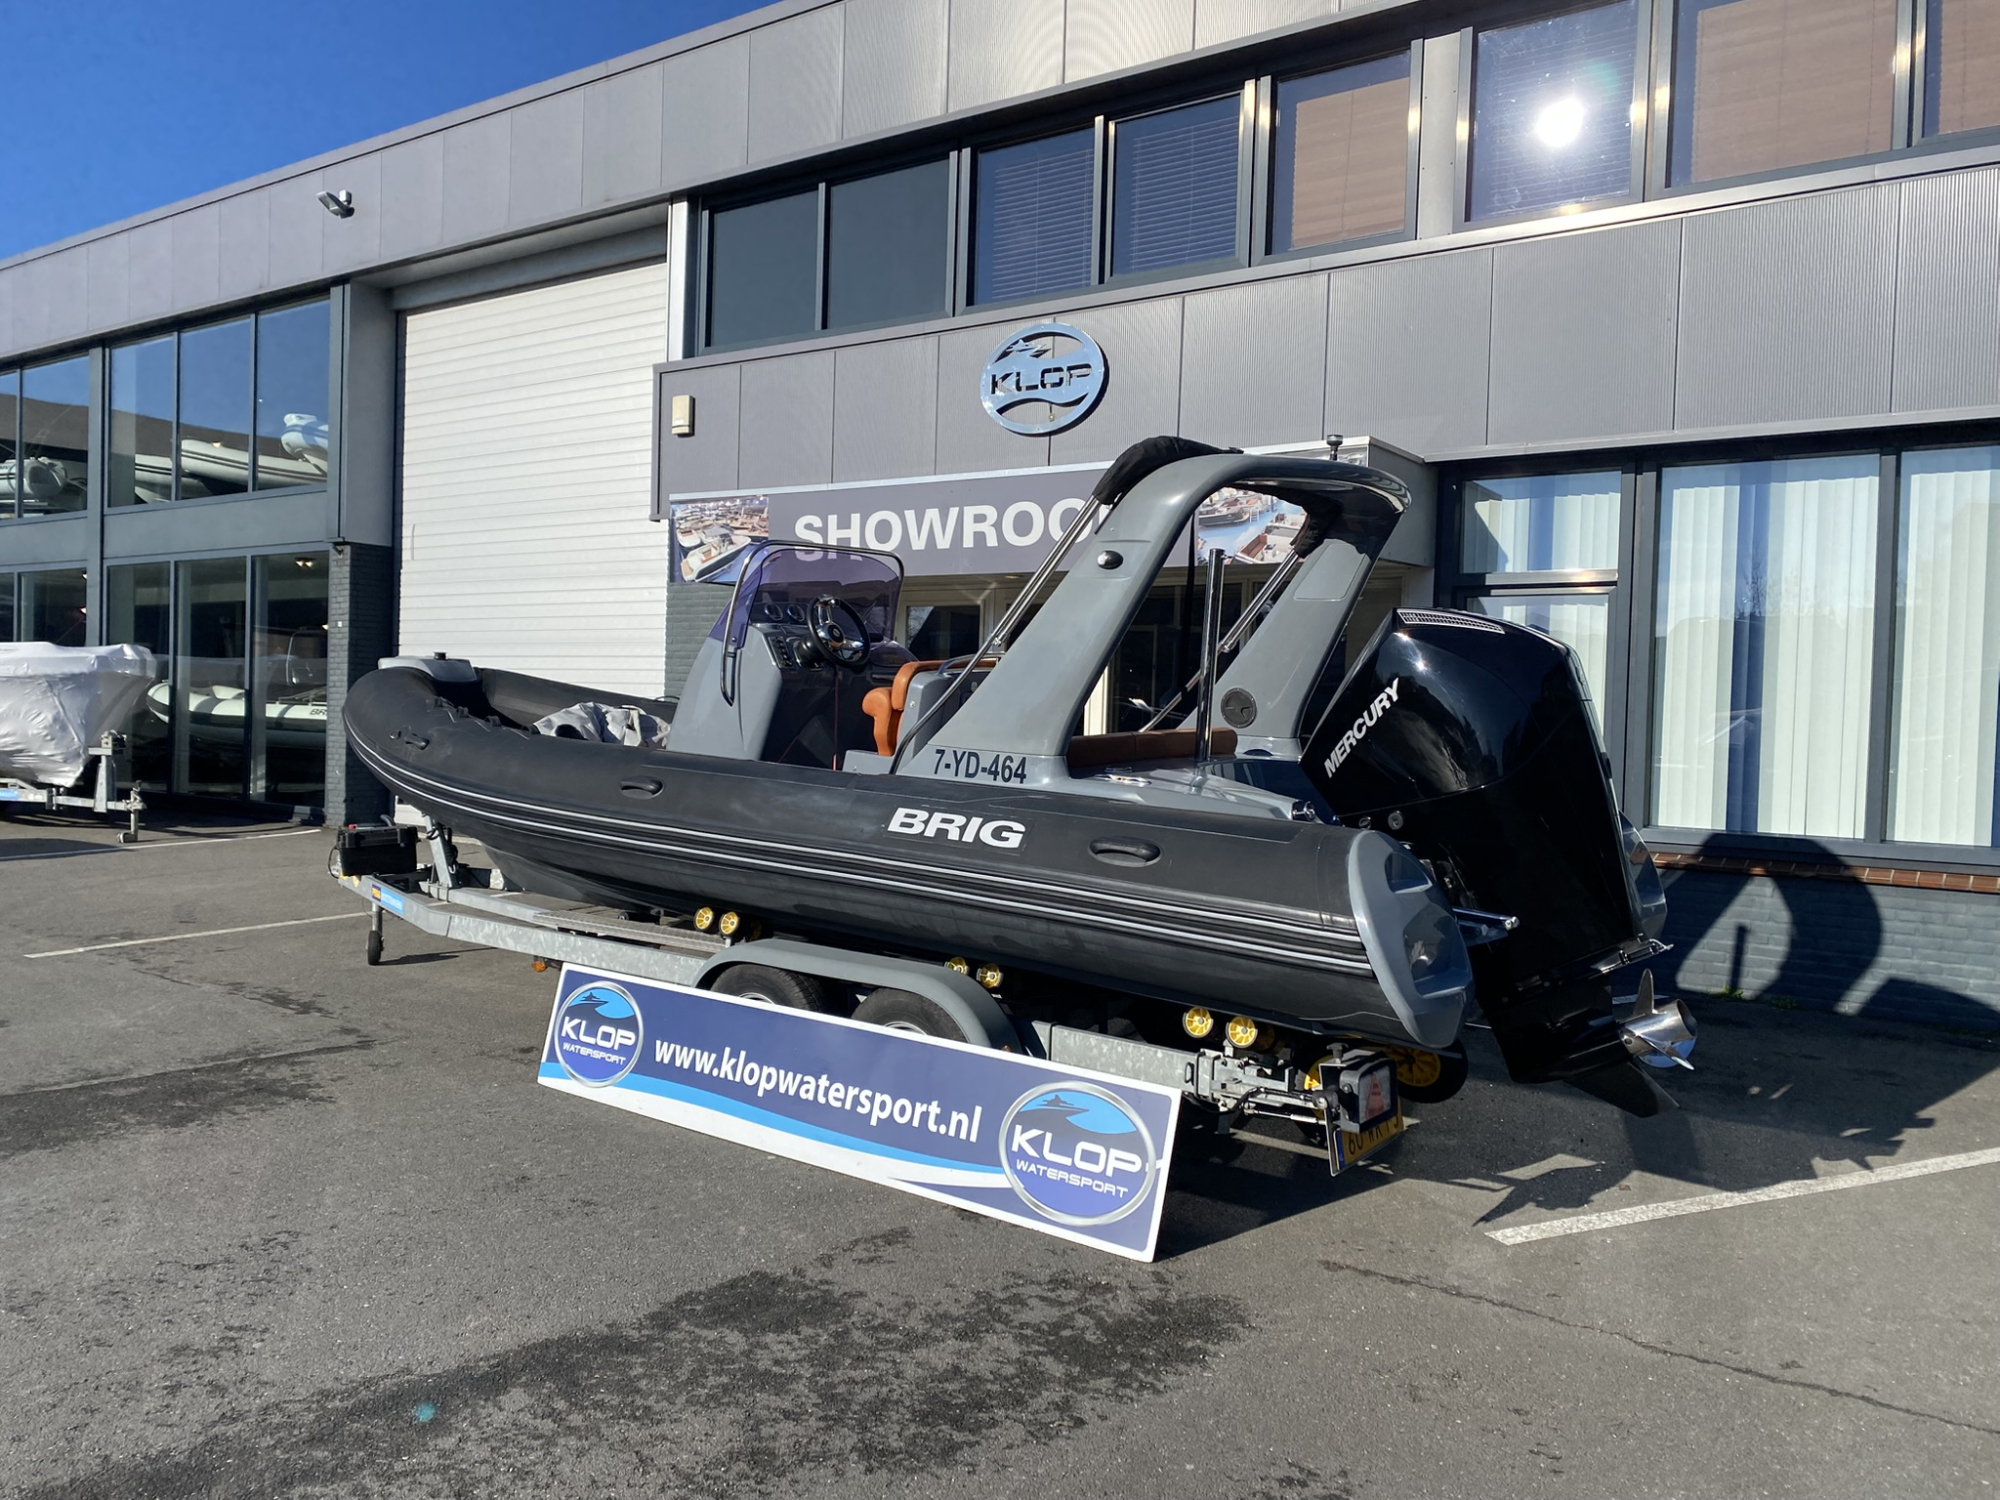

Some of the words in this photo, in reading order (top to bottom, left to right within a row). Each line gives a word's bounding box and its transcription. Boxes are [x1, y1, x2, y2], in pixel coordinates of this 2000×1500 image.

[990, 363, 1092, 395] KLOP
[794, 497, 1113, 562] SHOWROO
[1323, 677, 1400, 778] MERCURY
[934, 749, 1027, 784] 7-YD-464
[887, 807, 1026, 849] BRIG
[561, 1016, 636, 1050] KLOP
[562, 1042, 626, 1066] WATERSPORT
[654, 1039, 983, 1143] www.klopwatersport.nl
[1011, 1124, 1143, 1178] KLOP
[1016, 1158, 1129, 1199] WATERSPORT
